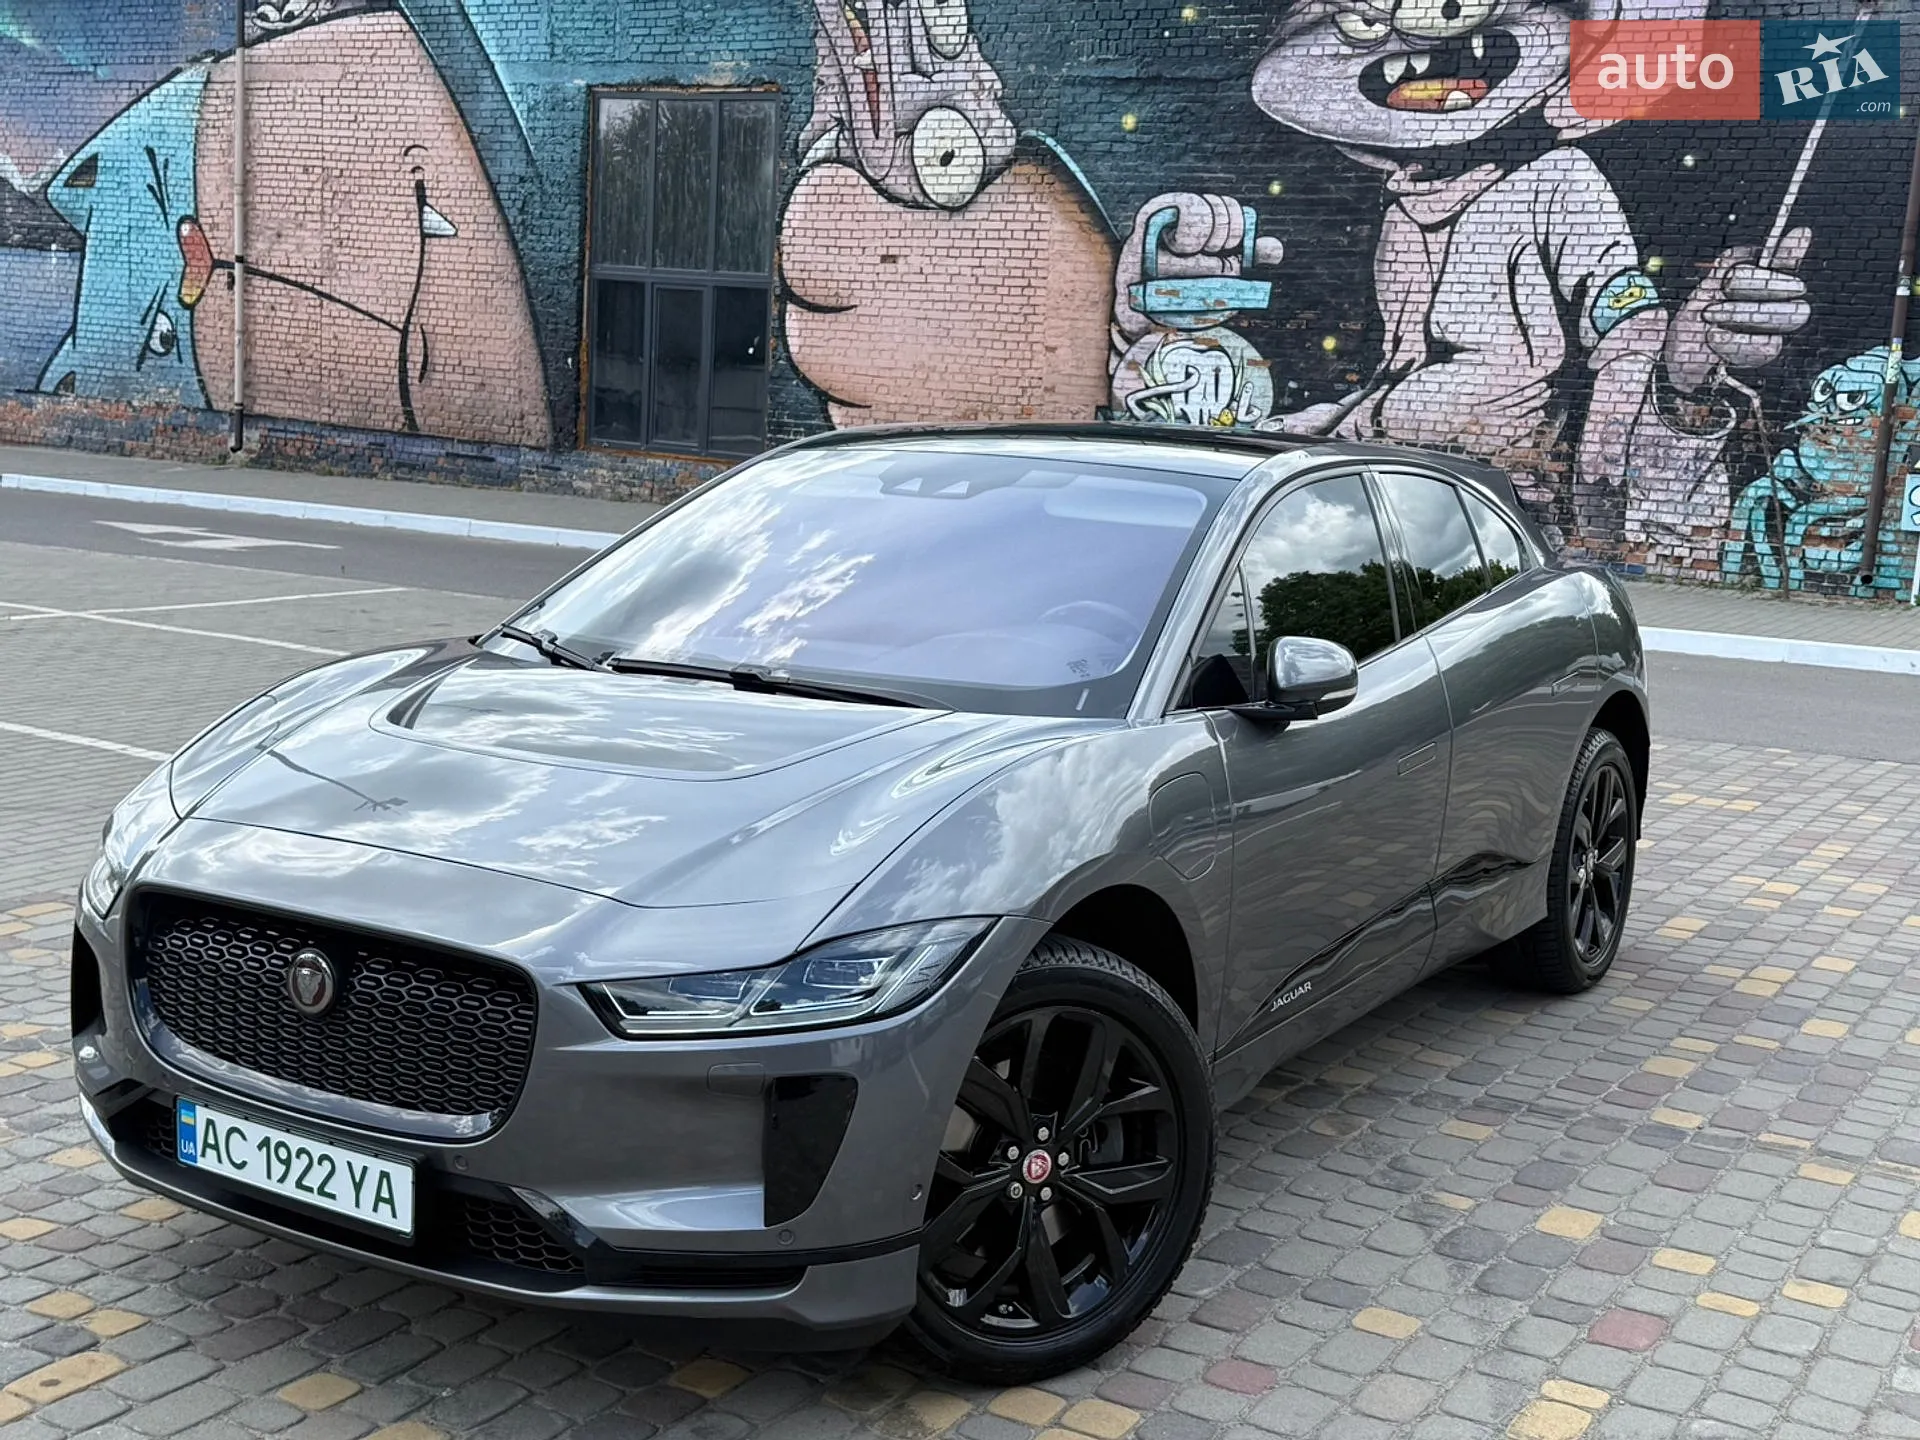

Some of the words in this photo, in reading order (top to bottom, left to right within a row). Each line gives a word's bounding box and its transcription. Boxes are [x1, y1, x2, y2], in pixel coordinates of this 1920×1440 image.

[1270, 981, 1312, 1012] JAGUAR
[181, 1139, 196, 1156] UA
[200, 1118, 248, 1170] AC
[256, 1136, 337, 1201] 1922
[346, 1160, 398, 1219] YA
